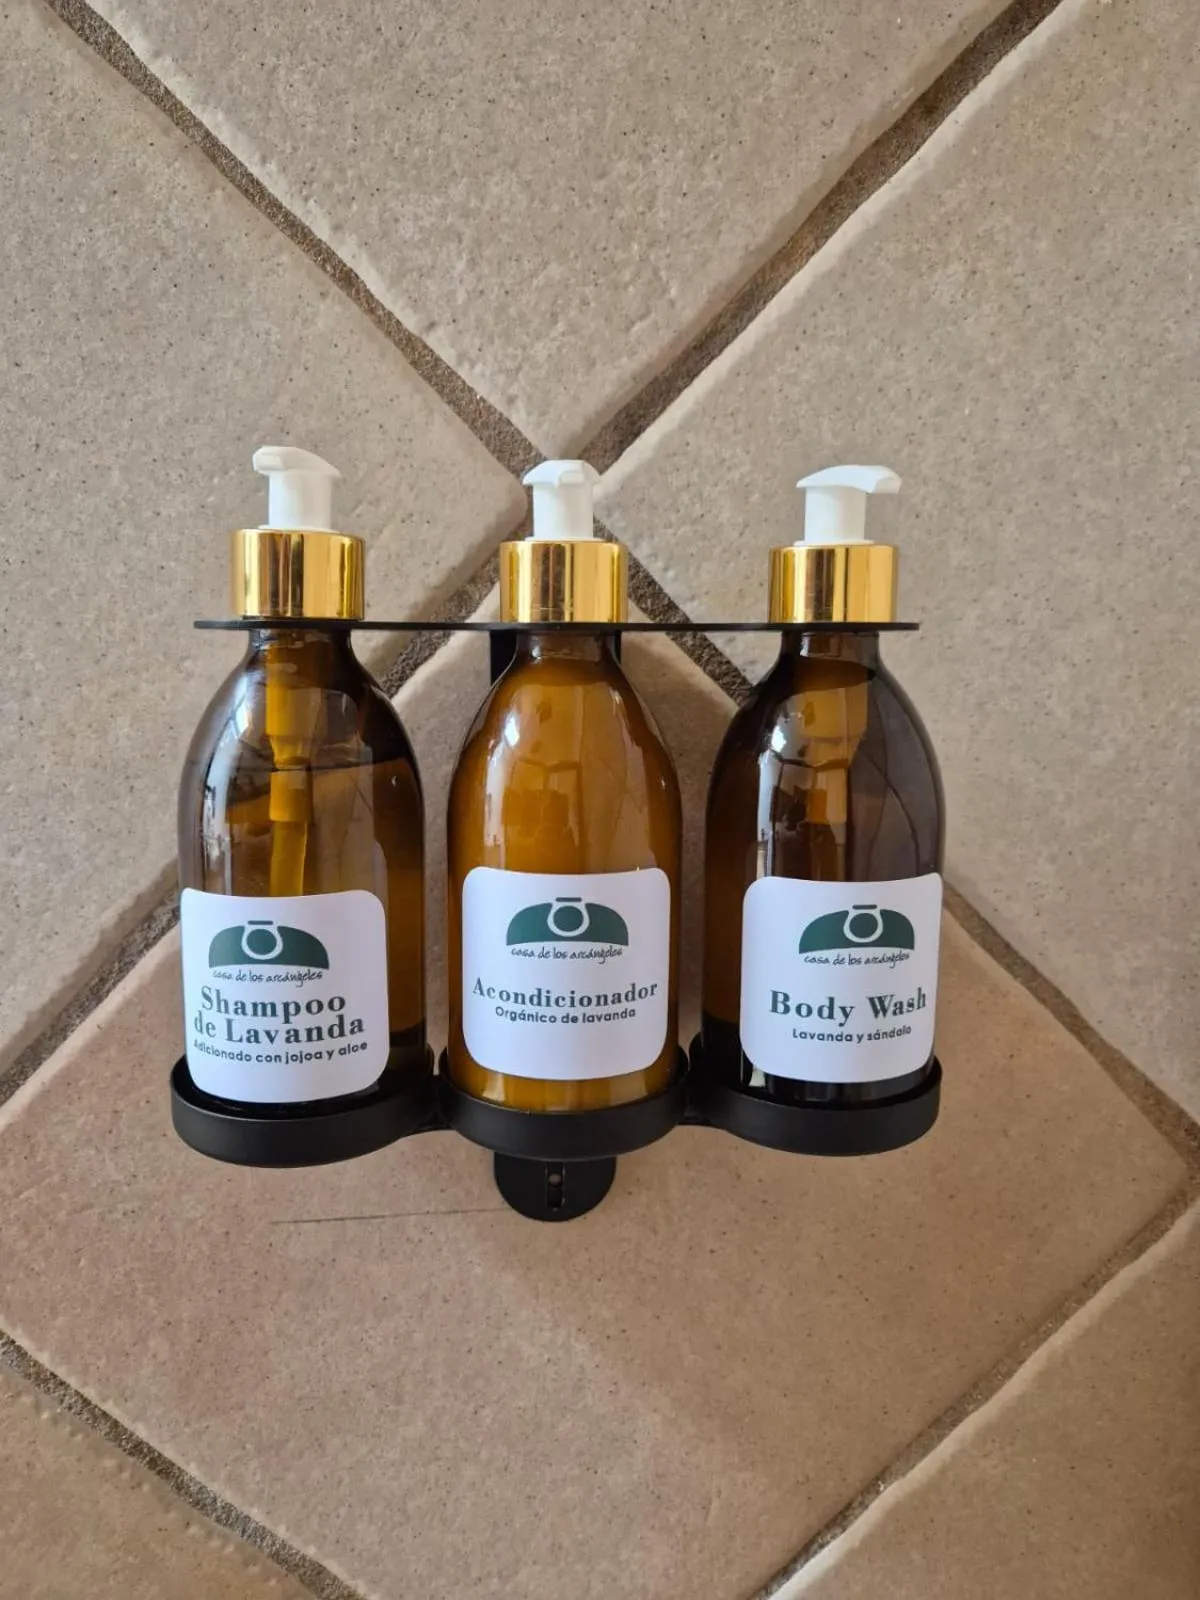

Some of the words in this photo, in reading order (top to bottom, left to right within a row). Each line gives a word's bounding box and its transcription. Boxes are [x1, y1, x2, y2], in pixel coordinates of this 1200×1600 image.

[511, 947, 535, 958] casa
[537, 946, 550, 959] de
[552, 947, 567, 960] los
[569, 945, 623, 964] arcángeles
[803, 955, 830, 964] casa
[832, 953, 845, 965] de
[847, 953, 862, 965] los
[212, 970, 234, 980] casa
[235, 968, 247, 982] de
[249, 968, 263, 982] los
[265, 968, 323, 988] arcángeles
[472, 976, 658, 1008] Acondicionador
[201, 984, 346, 1025] Shampoo
[495, 1006, 557, 1024] Orgánico
[561, 1012, 579, 1024] de
[582, 1007, 636, 1024] lavanda
[768, 989, 855, 1027] Body
[867, 987, 927, 1019] Wash
[193, 1009, 217, 1038] de
[224, 1014, 365, 1045] Lavanda
[792, 1028, 853, 1042] Lavanda
[856, 1032, 865, 1044] y
[867, 1025, 912, 1041] sándalo
[193, 1038, 252, 1063] Adicionado
[255, 1052, 282, 1064] con
[285, 1049, 323, 1065] jojoa
[326, 1048, 335, 1060] y
[338, 1041, 368, 1057] aloe
